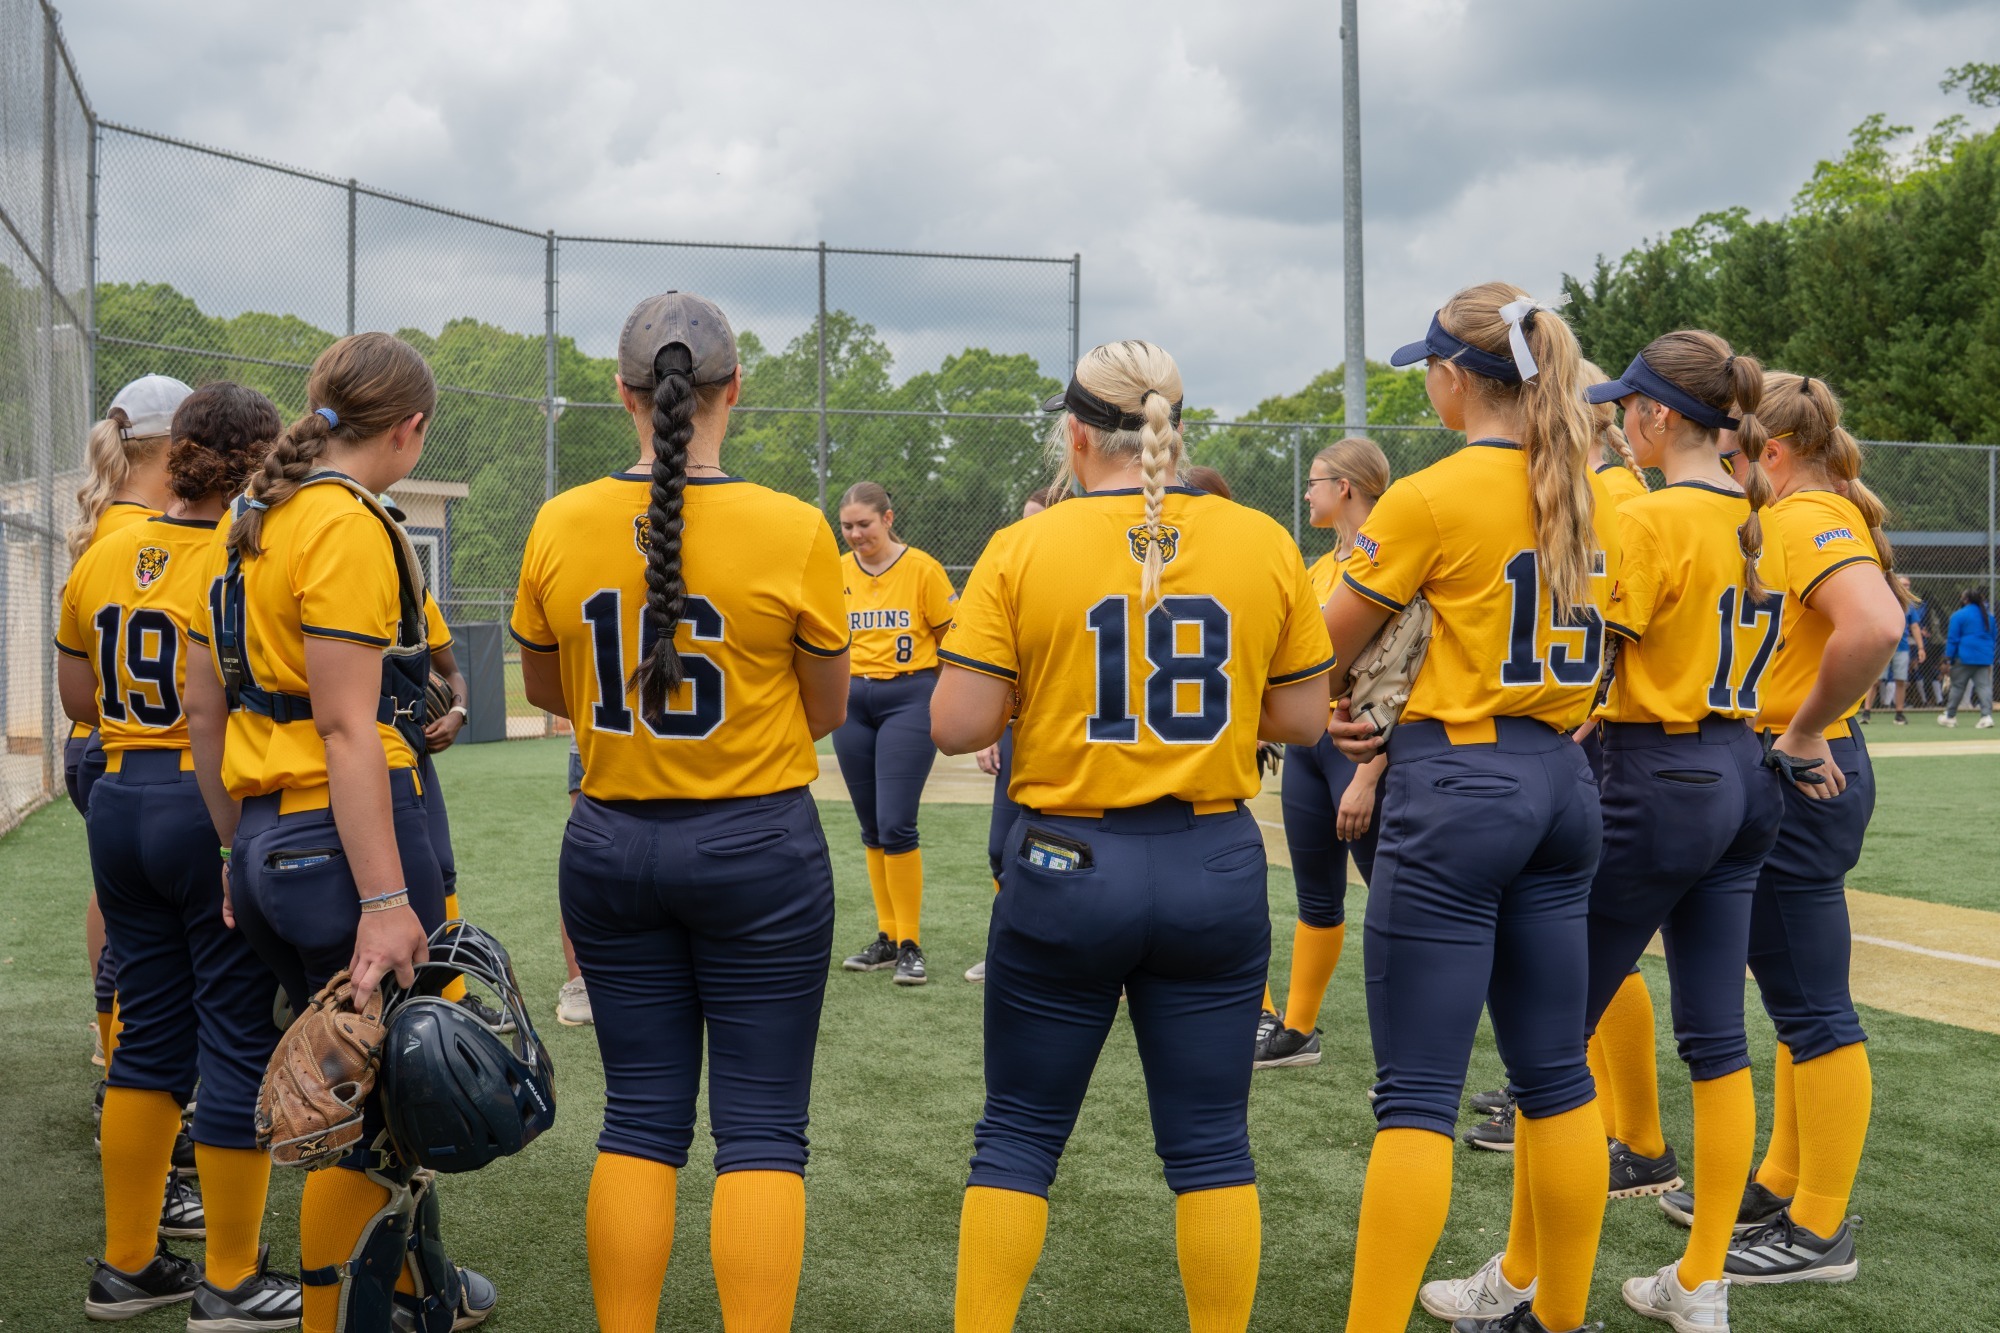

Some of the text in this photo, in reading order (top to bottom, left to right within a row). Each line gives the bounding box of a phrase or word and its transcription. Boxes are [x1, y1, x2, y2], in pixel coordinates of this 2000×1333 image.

[1813, 528, 1853, 549] NAIA
[95, 603, 183, 728] 19
[581, 588, 725, 740] 16
[847, 608, 911, 632] RUINS
[895, 633, 914, 664] 8
[1086, 594, 1231, 744] 18
[1500, 548, 1606, 686] 15
[1707, 584, 1786, 712] 17
[525, 1078, 547, 1112] EASTON
